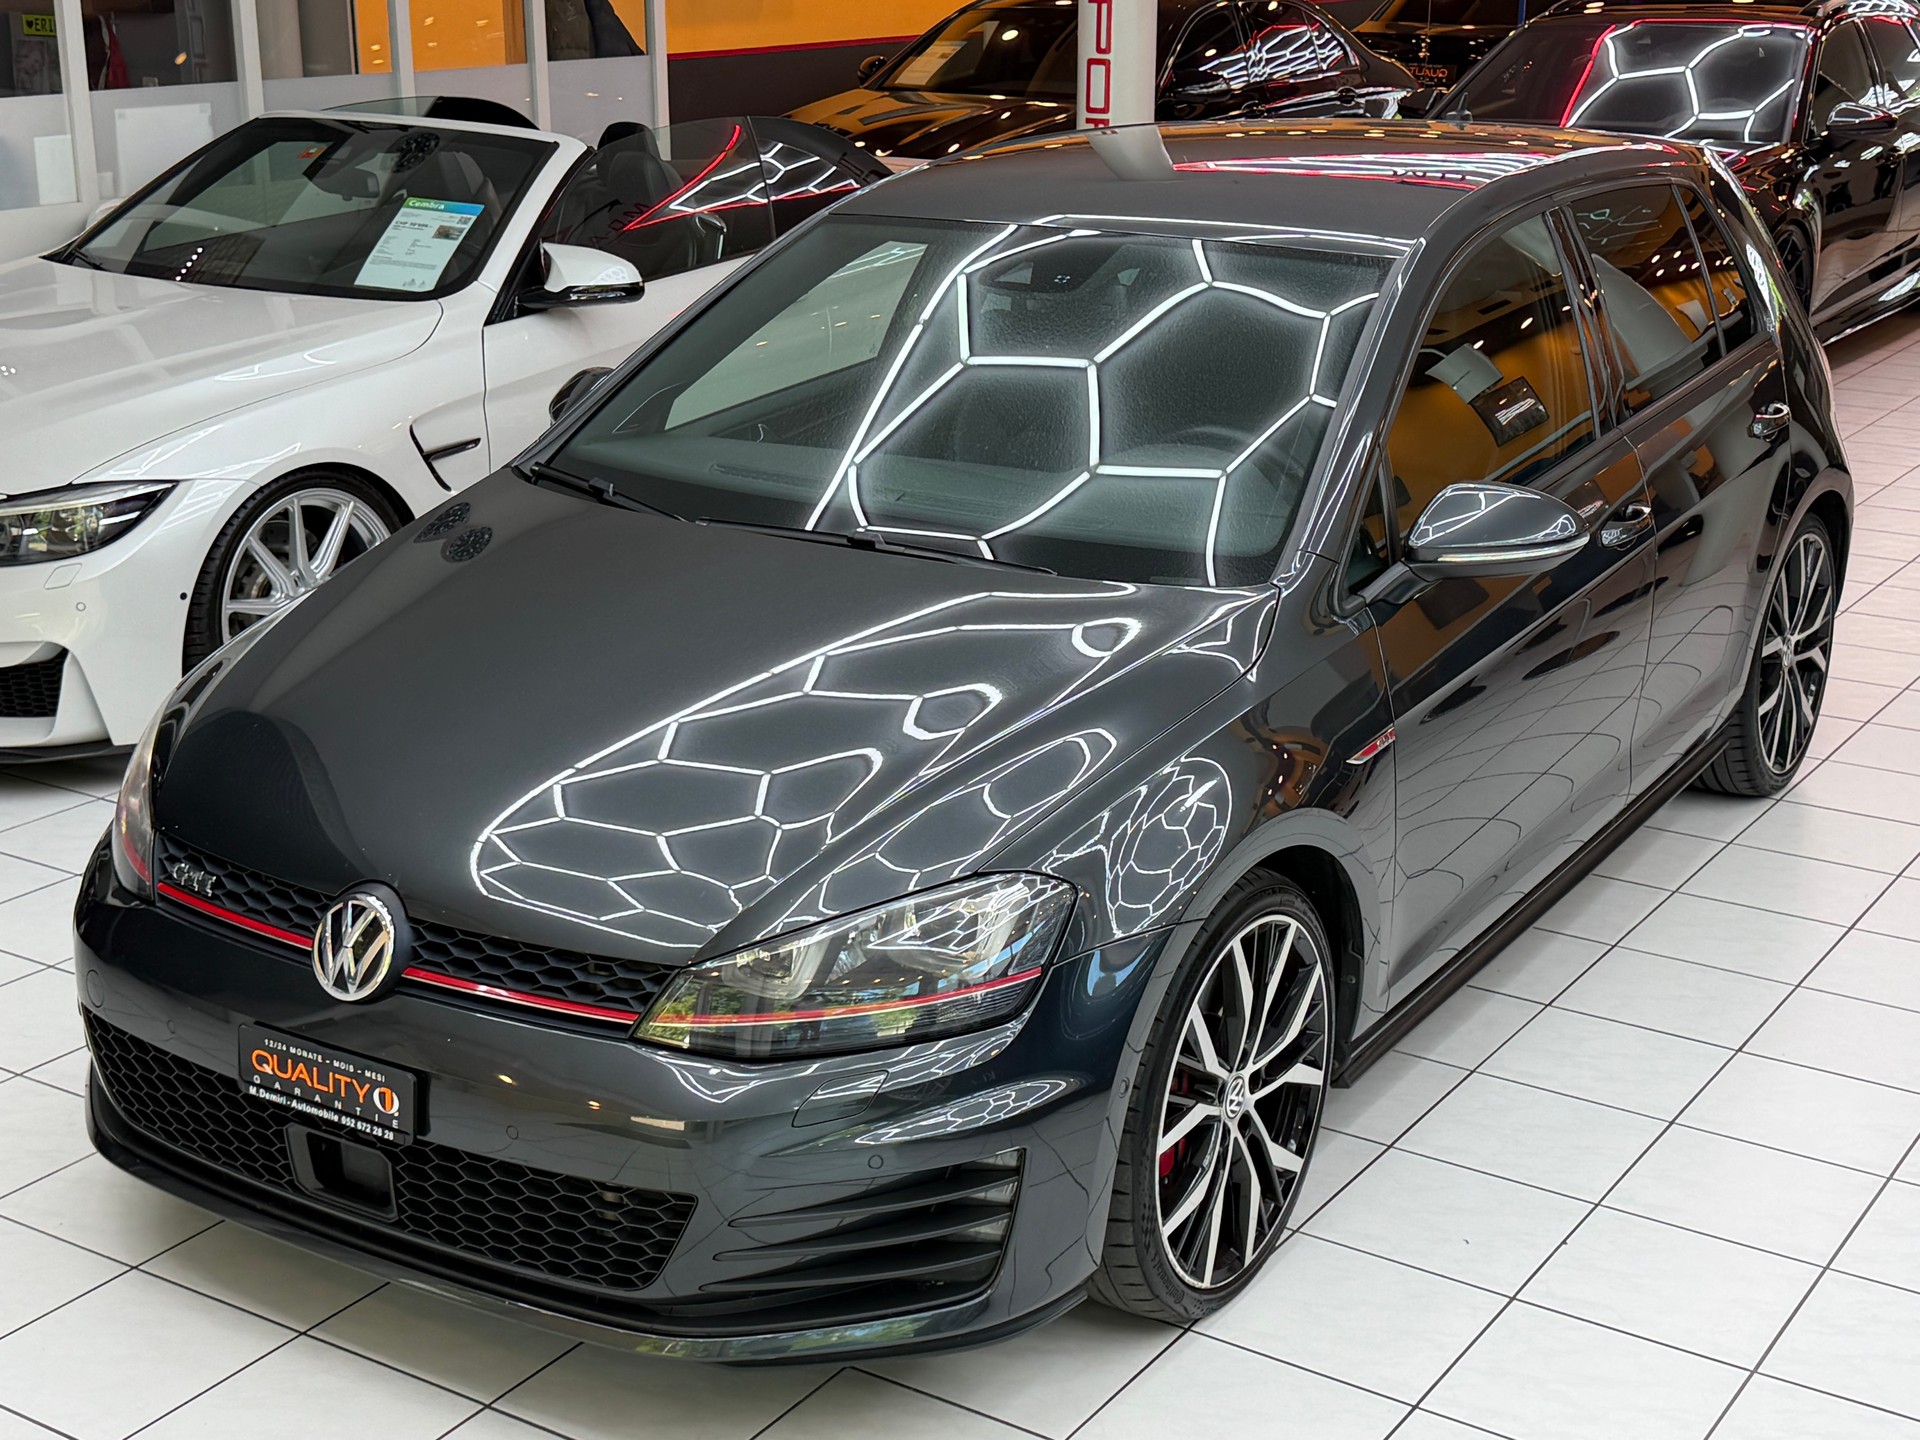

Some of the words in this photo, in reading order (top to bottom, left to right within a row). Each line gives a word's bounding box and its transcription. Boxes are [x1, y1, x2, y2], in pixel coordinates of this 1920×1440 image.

[1084, 0, 1113, 128] PO
[408, 199, 445, 210] Cembra
[173, 863, 217, 898] GTI
[251, 1049, 372, 1105] QUALITY
[264, 1038, 287, 1052] 12/24
[289, 1046, 323, 1063] MONATE
[333, 1060, 354, 1073] MOIS
[365, 1069, 386, 1083] MESI
[291, 1098, 340, 1122] Automobile
